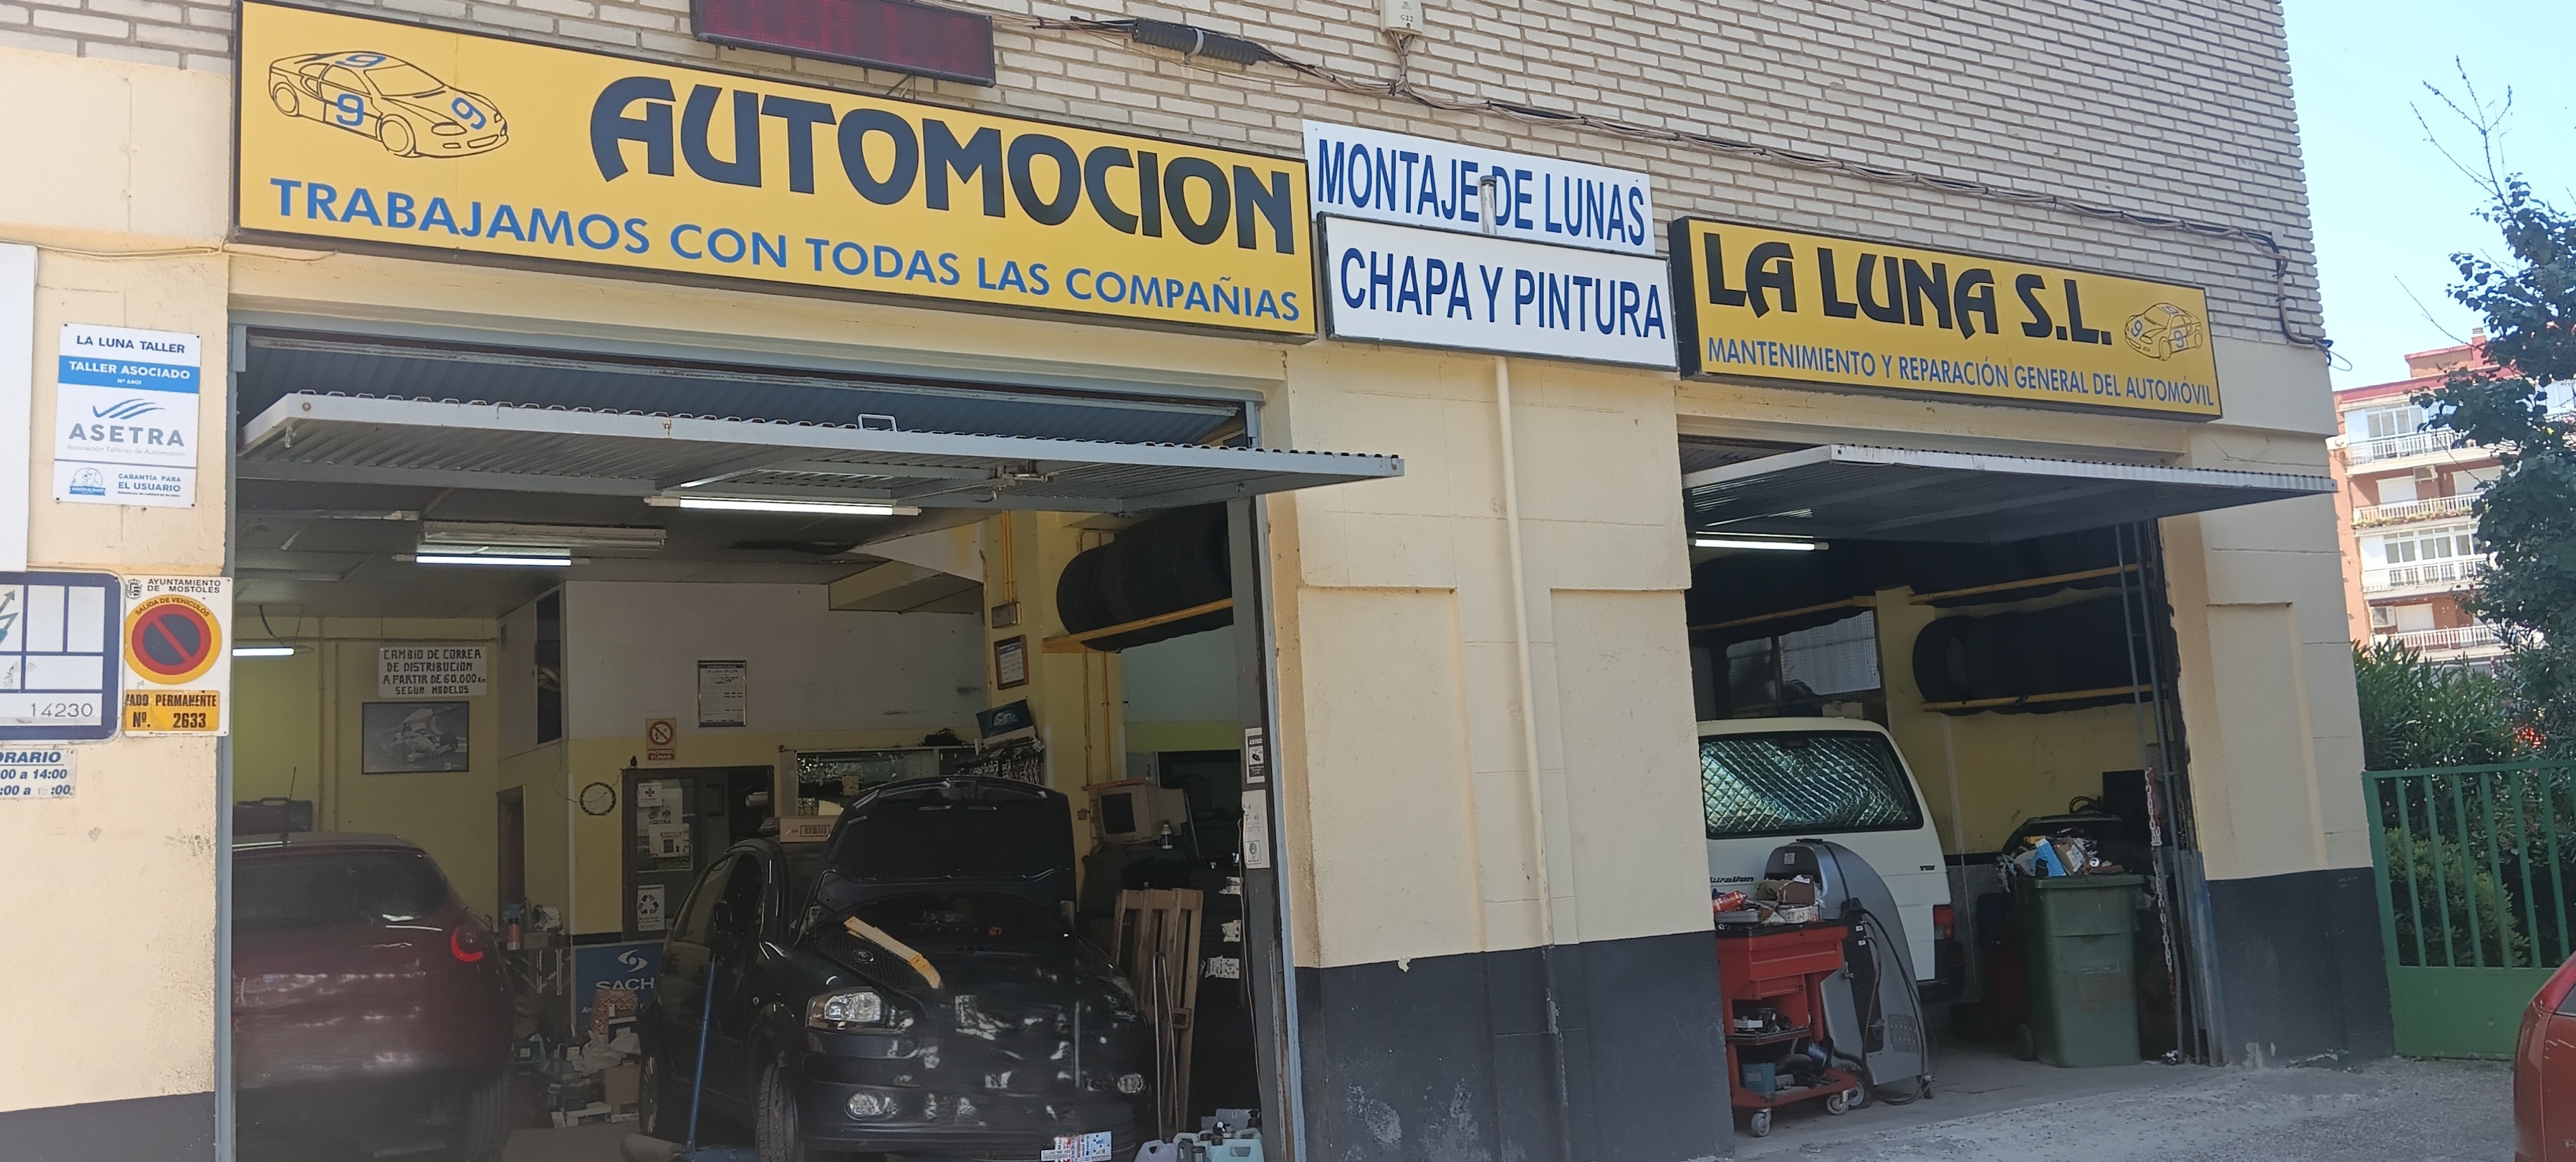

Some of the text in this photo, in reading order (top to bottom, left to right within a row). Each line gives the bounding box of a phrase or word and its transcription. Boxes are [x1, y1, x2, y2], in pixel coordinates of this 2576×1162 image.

[590, 76, 1295, 255] AUTOMOCION
[1318, 138, 1645, 246] MONTAJE DE LUNAS
[270, 177, 1300, 321] TRABAJAMOS CON TODAS LAS COMPAÑIAS
[1340, 247, 1666, 340] CHAPA Y PINTURA
[1703, 232, 2113, 345] LA LUNA S.L.
[76, 335, 185, 354] LA LUNA TALLER
[69, 360, 190, 380] TALLER ASOCIADO
[1708, 337, 2214, 407] MANTENIMIENTO Y REPARACIÓN GENERAL DEL AUTOMÓVIL
[68, 422, 185, 447] ASETRA
[133, 482, 181, 492] USUARIO
[147, 578, 221, 587] AYUNTAMIENTO
[169, 585, 220, 594] MOSTOLES
[134, 599, 159, 616] SALIDA
[383, 649, 482, 660] CAMBIO DE CORREA
[387, 662, 473, 672] DE DISTRIBUCION
[383, 675, 391, 685] A
[393, 674, 428, 685] PARTIR
[430, 674, 442, 684] DE
[443, 673, 477, 684] 60.000
[395, 685, 469, 695] SEGUN MODELOS
[155, 694, 217, 707] PERMANENTE
[31, 702, 93, 717] 14230
[172, 712, 206, 728] 2633
[20, 771, 28, 779] a
[33, 769, 68, 779] 14:00
[23, 787, 32, 795] a
